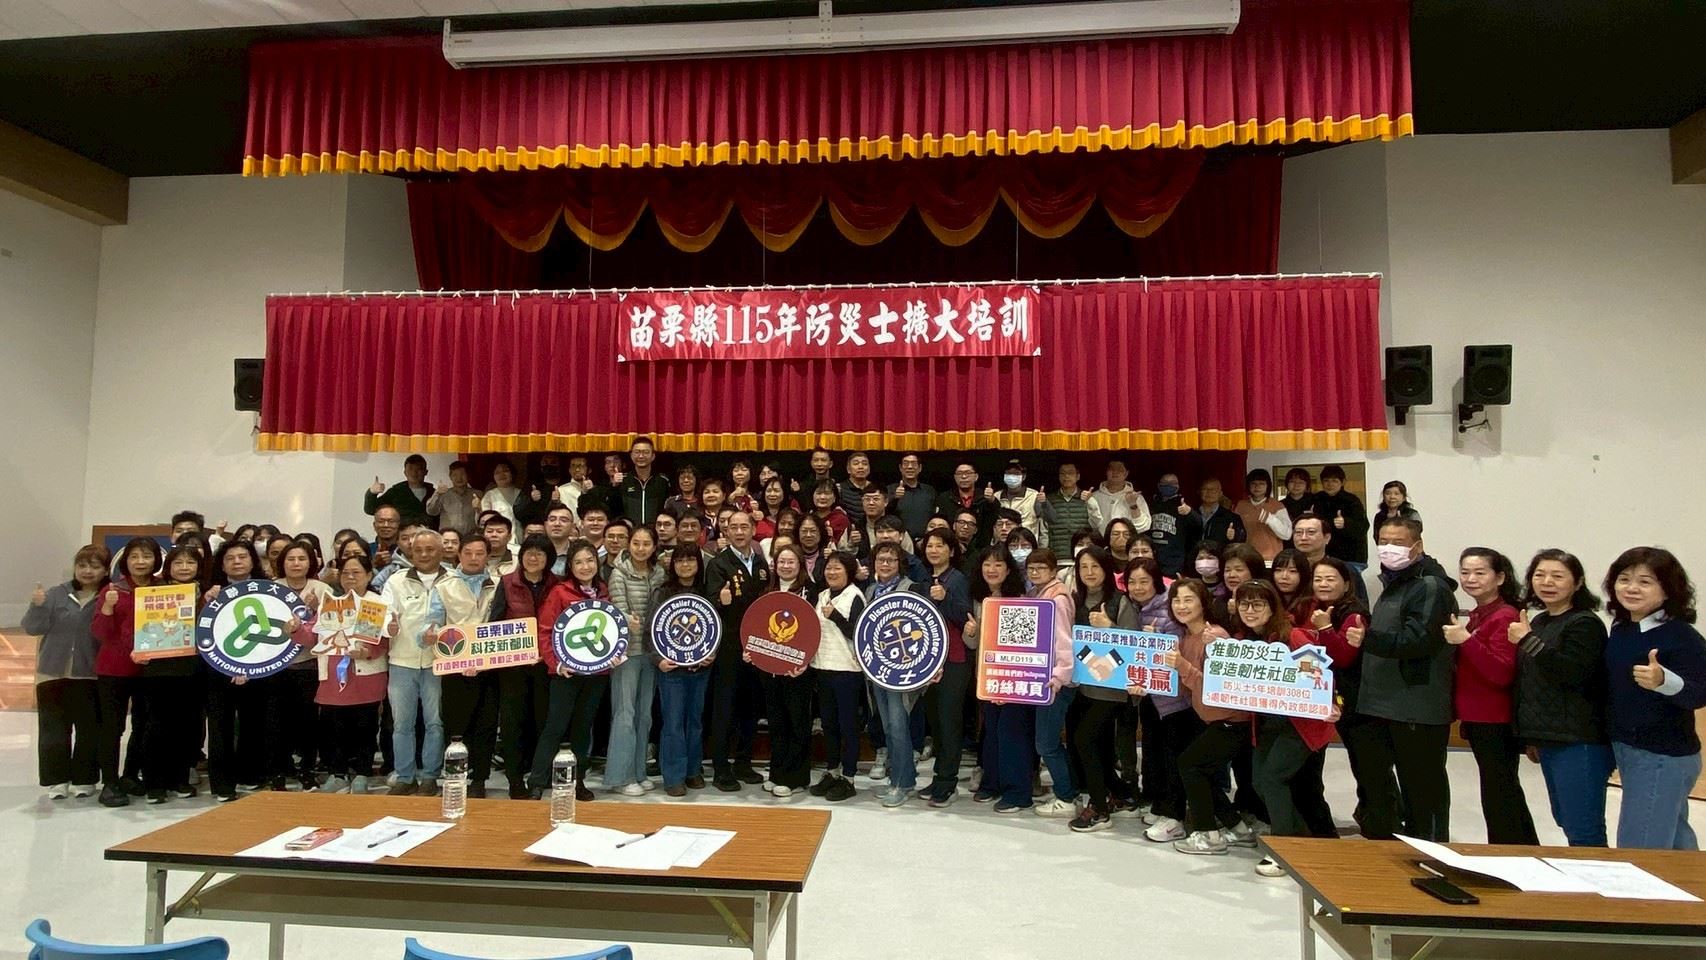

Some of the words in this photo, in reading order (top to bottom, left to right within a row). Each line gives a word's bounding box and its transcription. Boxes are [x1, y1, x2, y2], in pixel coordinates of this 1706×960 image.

[629, 296, 1029, 350] 苗栗縣115年防災士擴大培訓
[199, 581, 298, 628] 國立聯合大學
[476, 622, 527, 639] 苗栗觀光
[868, 601, 901, 622] Disaster
[902, 599, 928, 616] Relief
[924, 613, 941, 657] Volunteer
[470, 636, 534, 655] 科技新都心
[666, 641, 710, 663] 防災士
[1211, 641, 1285, 662] 推動防災士
[207, 651, 247, 675] NATIONAL
[249, 661, 282, 674] UNITED
[862, 643, 917, 685] 防災士
[999, 655, 1033, 663] MLFD119
[1127, 665, 1171, 692] 雙贏
[1208, 660, 1298, 683] 營造韌性社區
[985, 679, 1044, 697] 粉絲專頁
[1223, 681, 1311, 699] 防災士5年培訓308位
